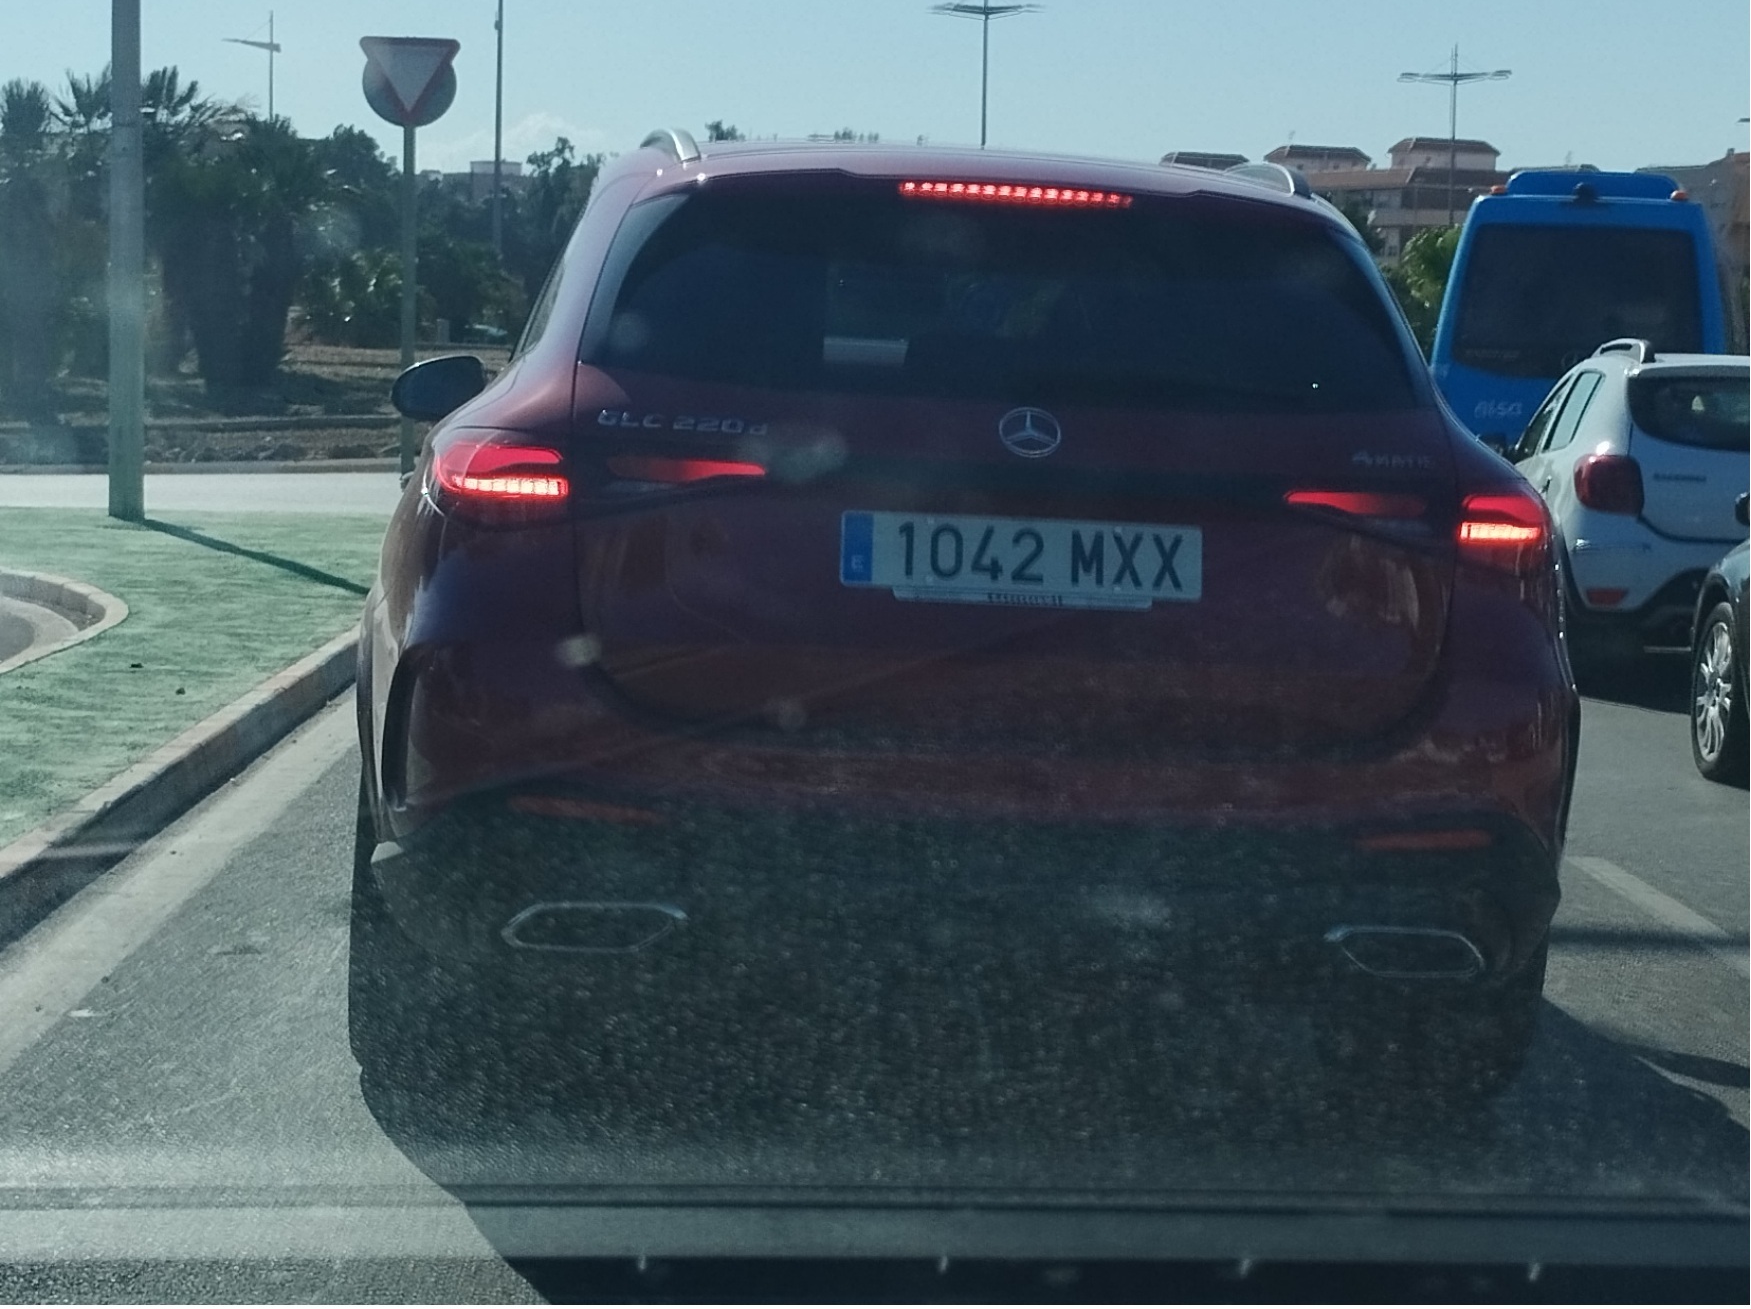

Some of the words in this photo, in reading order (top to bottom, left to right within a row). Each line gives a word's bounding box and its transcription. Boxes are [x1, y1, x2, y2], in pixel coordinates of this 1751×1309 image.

[597, 408, 664, 427] GLC
[672, 415, 744, 433] 220
[749, 422, 769, 436] d
[897, 521, 1045, 585] 1042
[1070, 528, 1183, 592] MXX
